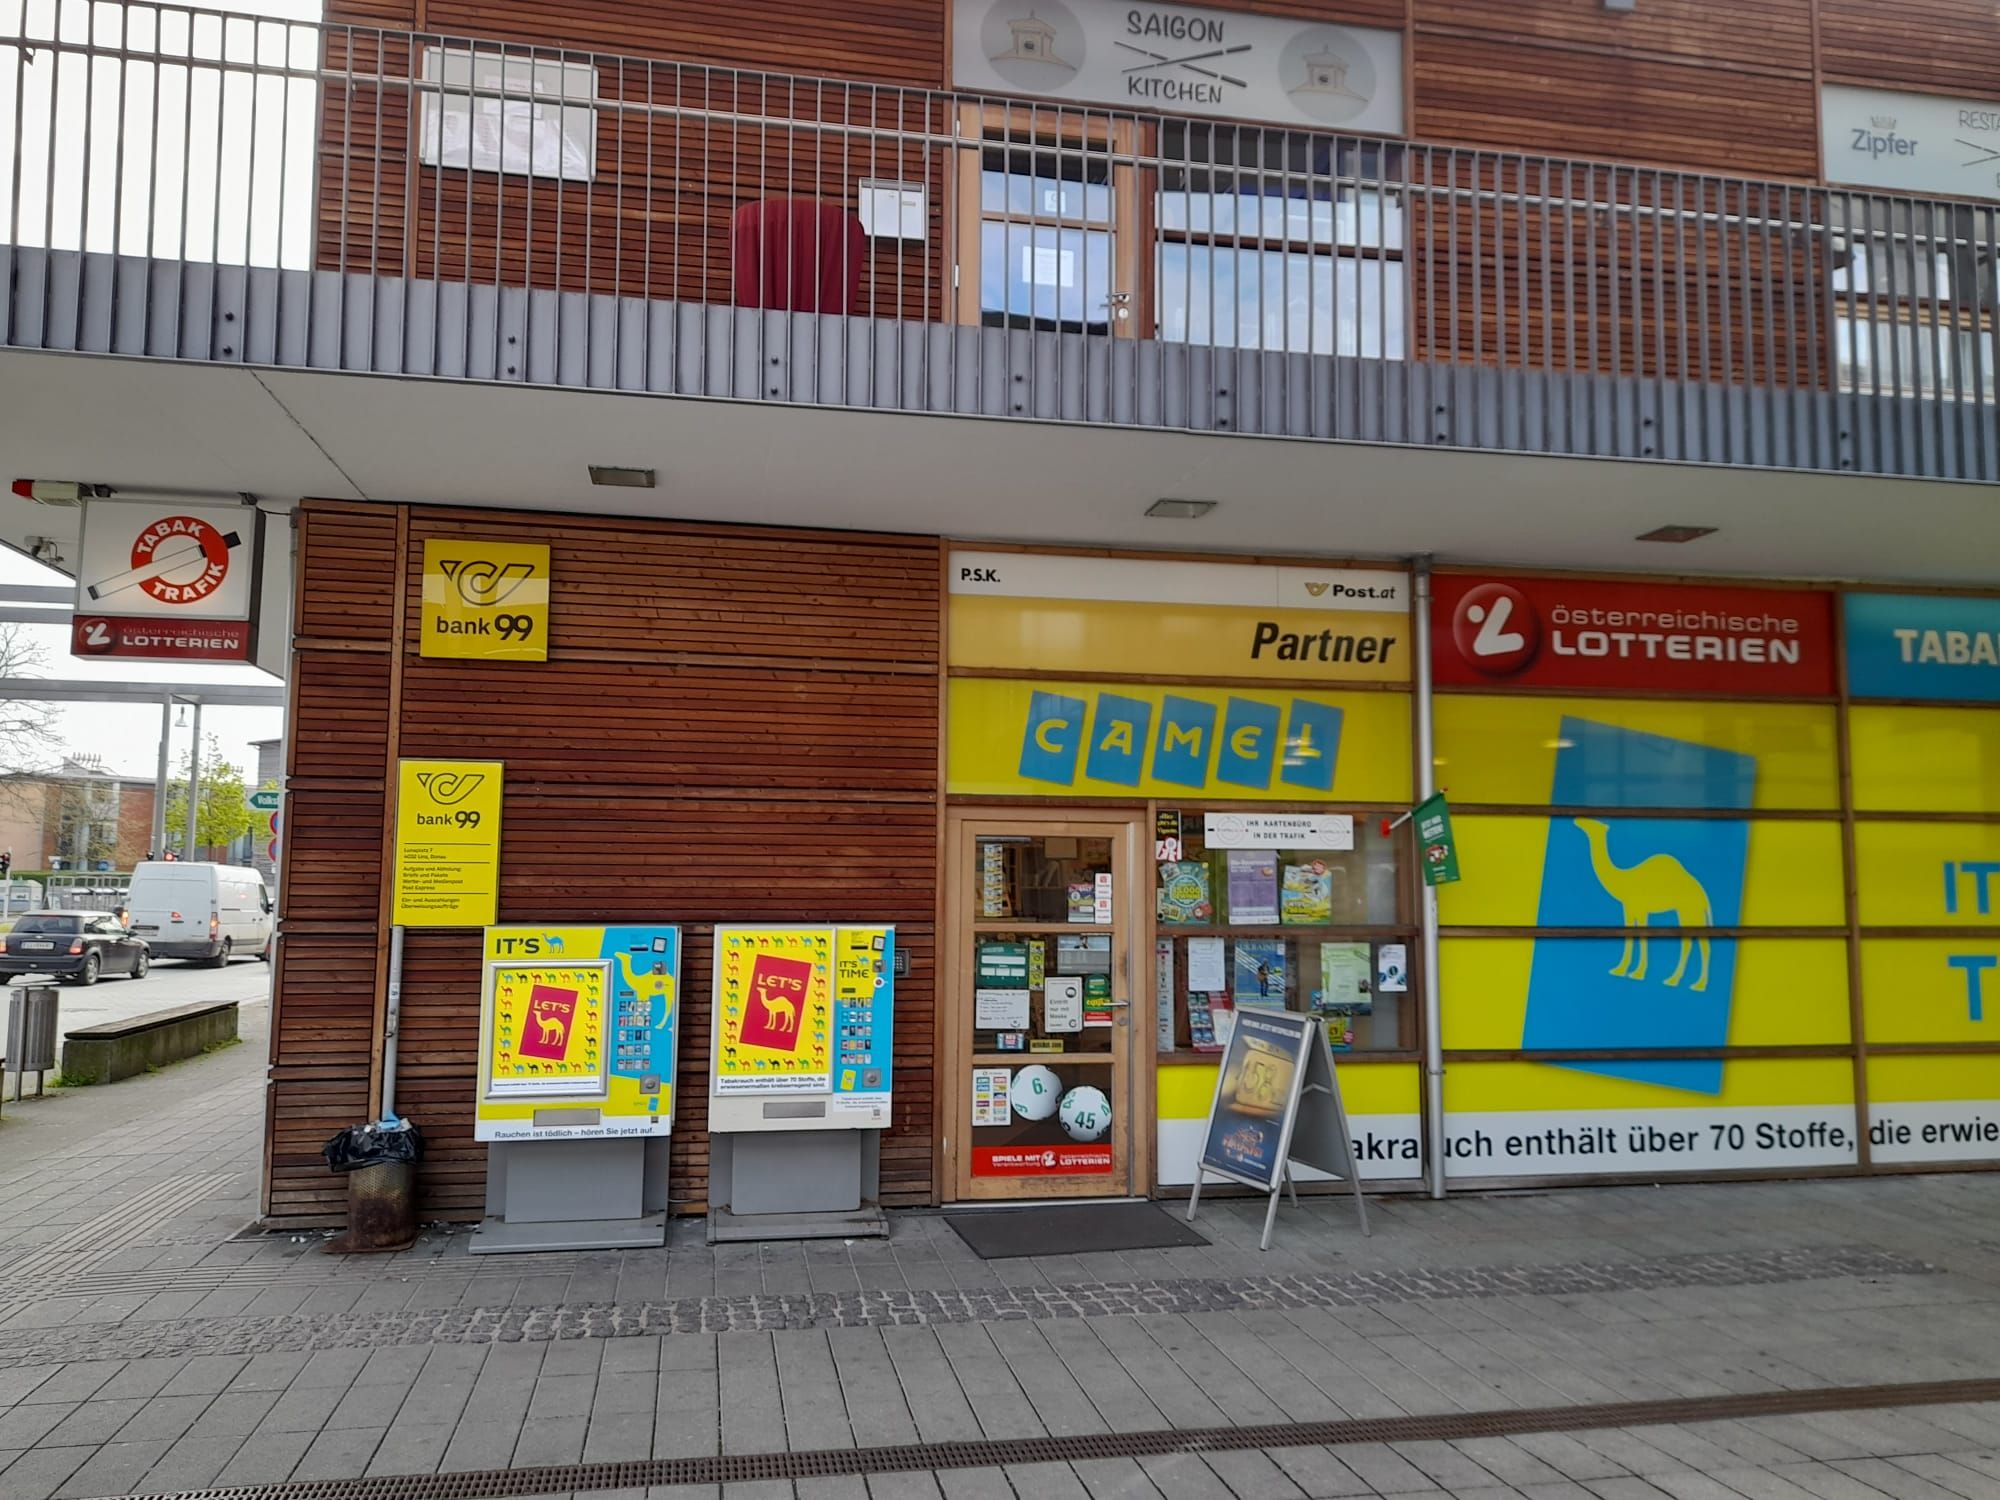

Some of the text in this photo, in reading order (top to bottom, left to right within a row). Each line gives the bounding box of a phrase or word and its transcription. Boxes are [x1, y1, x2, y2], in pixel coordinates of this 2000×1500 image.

[1127, 9, 1224, 43] SAIGON
[1128, 75, 1222, 104] KITCHEN
[1851, 128, 1918, 160] Zipfer
[137, 519, 204, 554] TABAK
[152, 561, 224, 601] TRAFIK
[961, 567, 1001, 582] P.S.K.
[1333, 584, 1396, 599] Post.at
[436, 614, 533, 641] bank 99
[1551, 604, 1799, 634] österreichische
[122, 635, 239, 649] LOTTERIEN
[1250, 621, 1397, 663] Partner
[1552, 630, 1800, 664] LOTTERIEN
[1893, 628, 2000, 665] TABA
[1035, 719, 1321, 759] CAMEL
[416, 811, 481, 829] bank 99
[1263, 820, 1312, 828] KARTENBÜRO
[496, 938, 540, 954] IT'S
[839, 960, 858, 969] IT'S
[839, 969, 869, 979] TIME
[757, 973, 802, 991] LET'S
[533, 999, 571, 1014] LET'S
[544, 1129, 572, 1137] tödlich
[581, 1128, 605, 1136] hören
[606, 1127, 619, 1135] Sie
[620, 1127, 638, 1136] jetzt
[639, 1126, 655, 1134] auf.
[1074, 1111, 1096, 1130] 45
[1505, 1127, 1617, 1156] enthält
[1628, 1126, 1699, 1152] über
[1710, 1124, 1745, 1150] 70
[1755, 1121, 1855, 1151] Stoffe,
[1868, 1119, 1912, 1145] die
